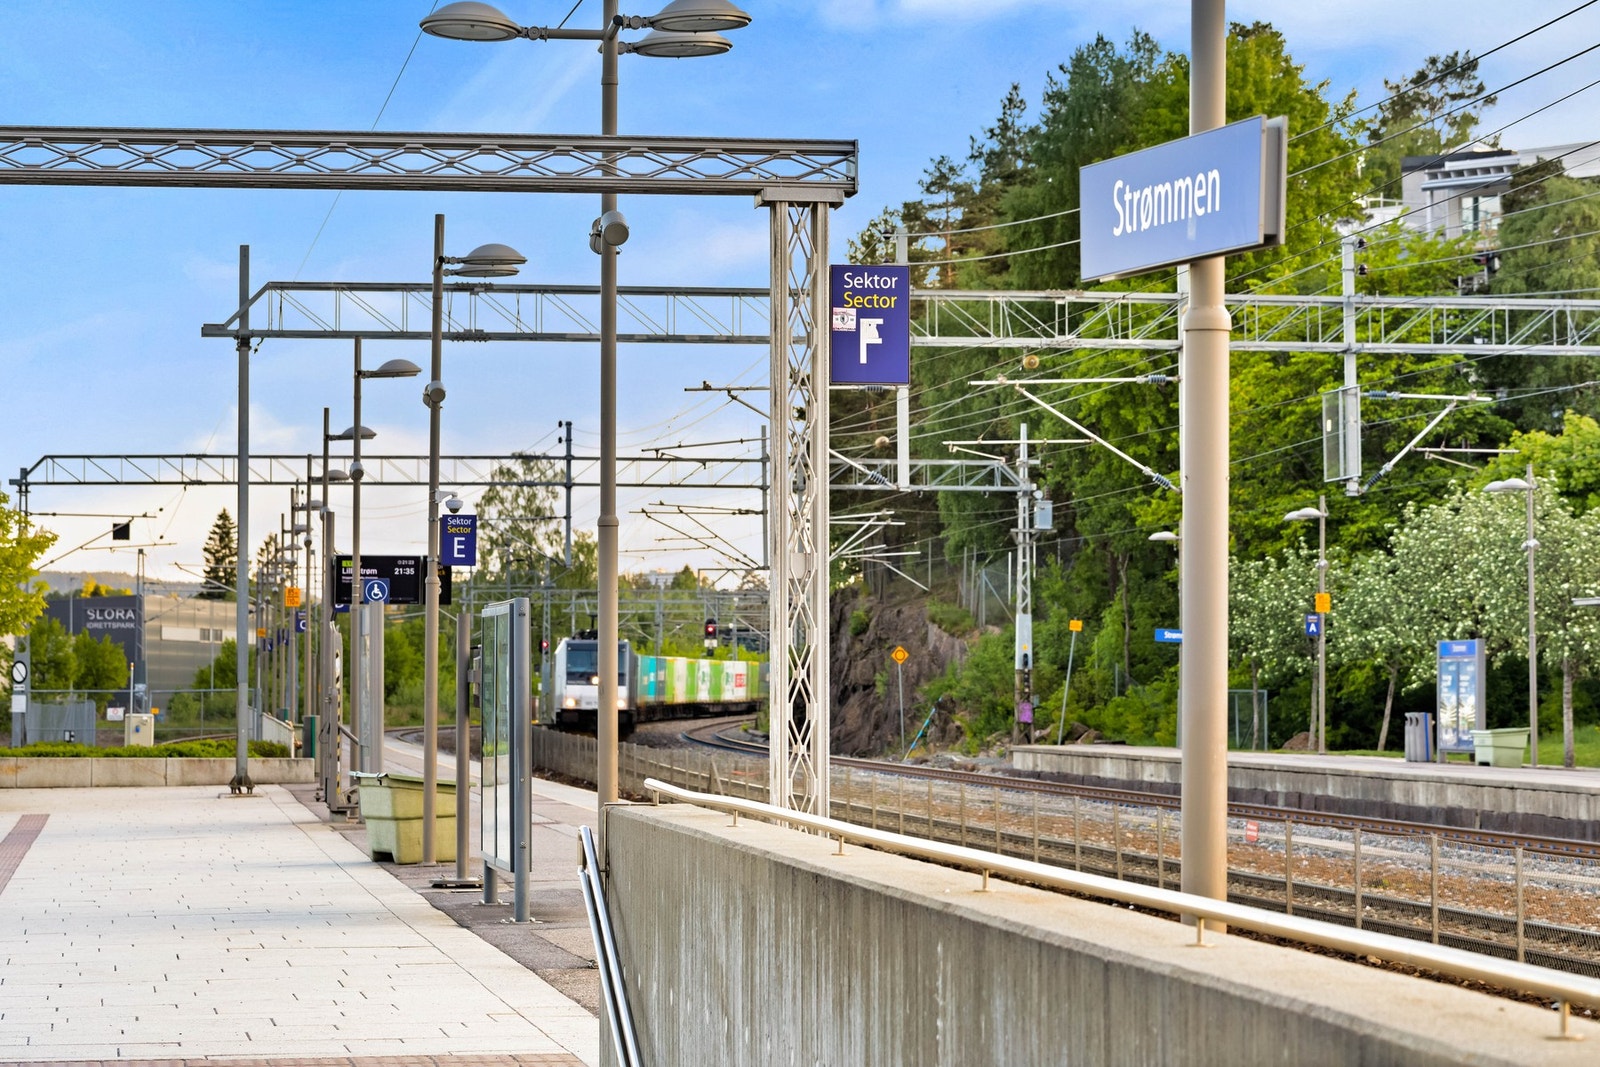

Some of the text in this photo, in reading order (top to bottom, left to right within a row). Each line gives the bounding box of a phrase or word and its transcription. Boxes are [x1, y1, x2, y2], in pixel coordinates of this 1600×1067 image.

[1113, 169, 1220, 237] Strømmen
[844, 272, 898, 289] Sektor
[844, 291, 897, 308] Sector
[860, 318, 884, 364] F
[447, 517, 472, 525] Sektor
[454, 537, 466, 557] E
[342, 567, 378, 575] Lilltrøm
[87, 609, 135, 620] SLORA
[1309, 623, 1317, 632] A
